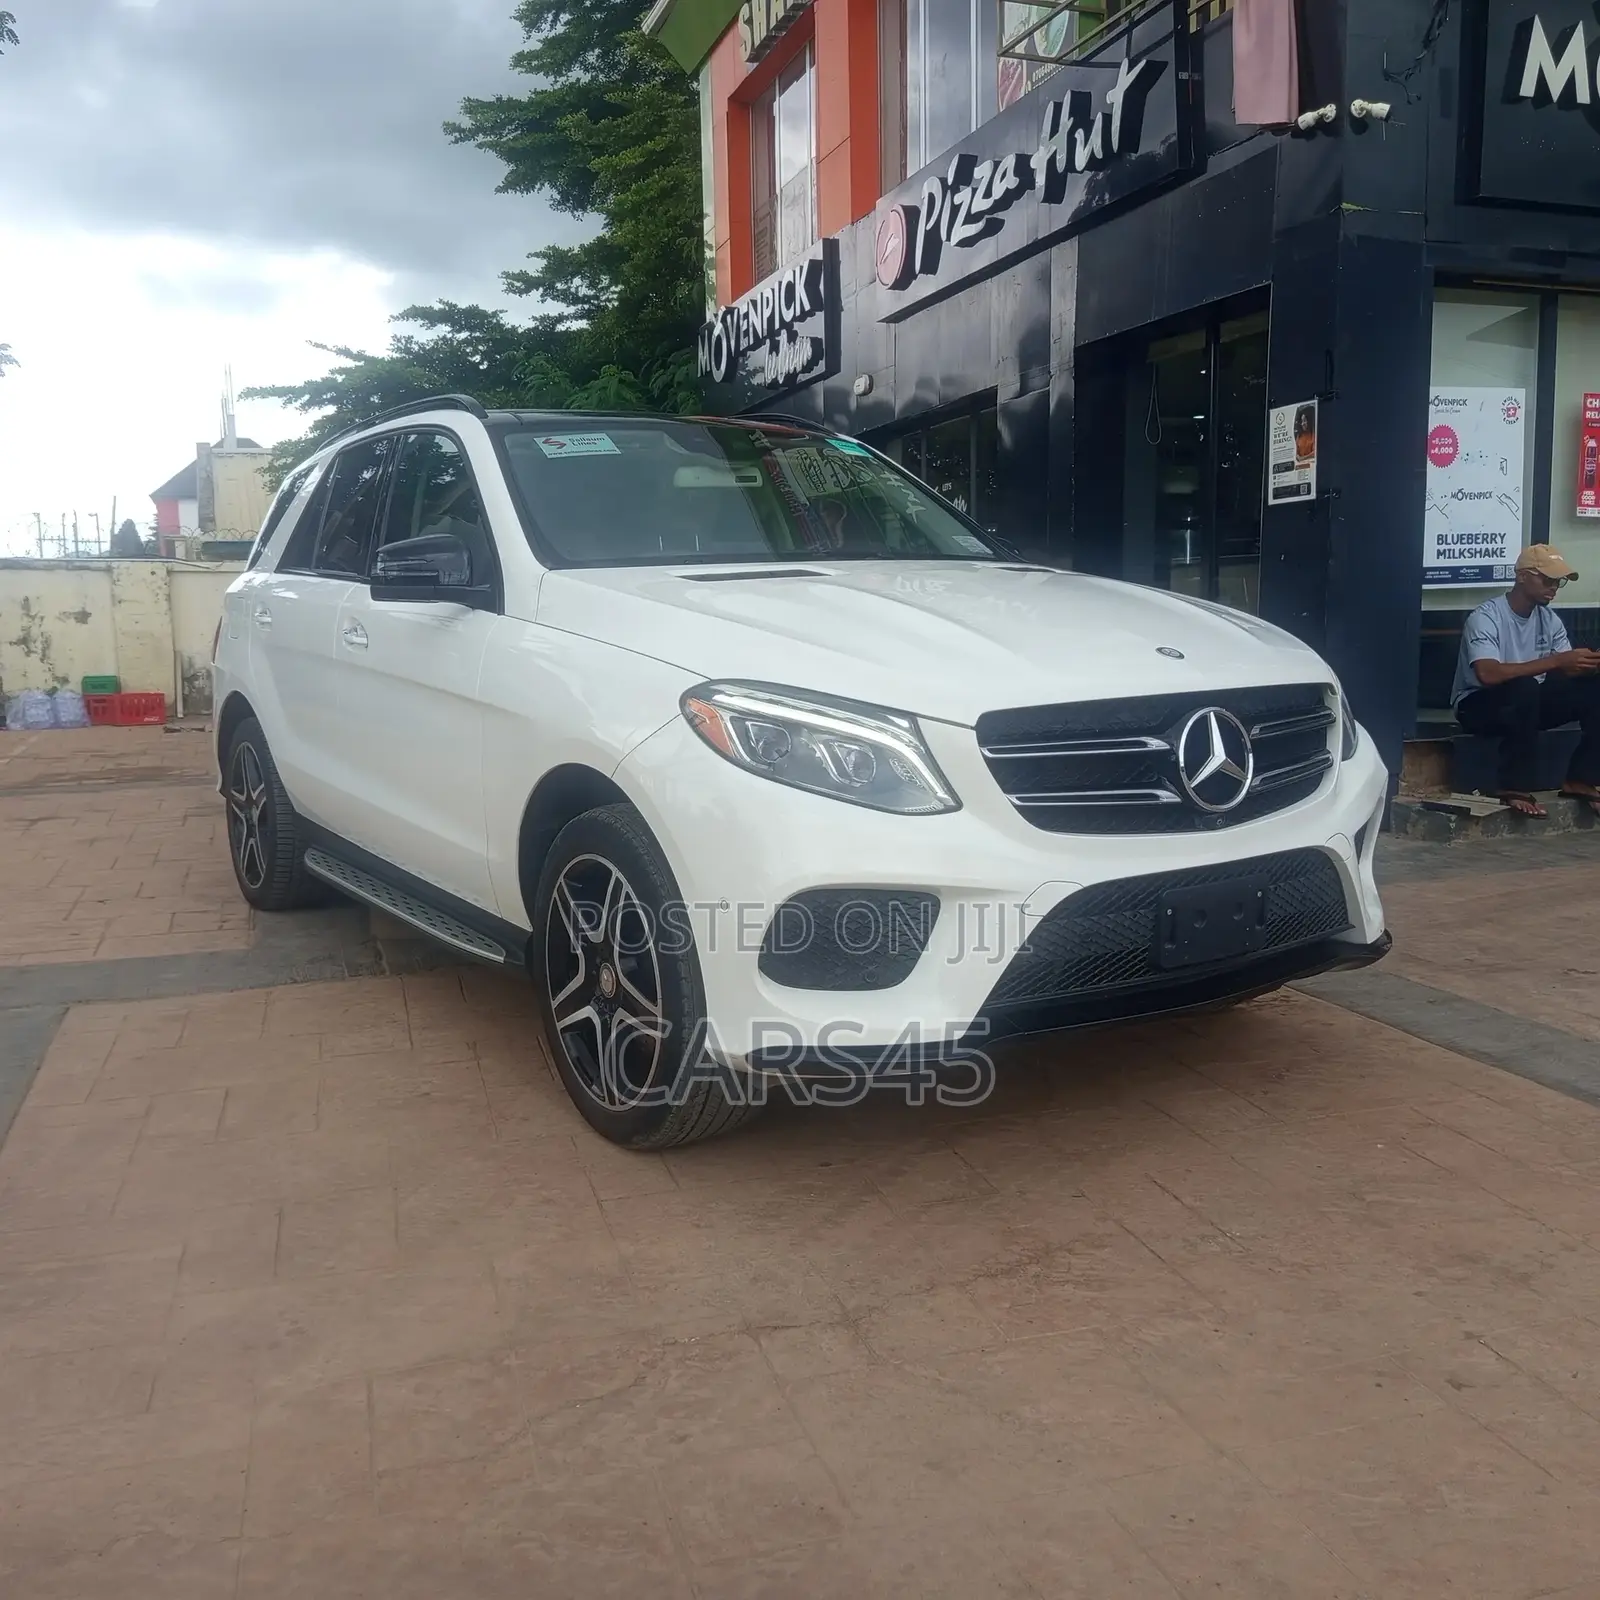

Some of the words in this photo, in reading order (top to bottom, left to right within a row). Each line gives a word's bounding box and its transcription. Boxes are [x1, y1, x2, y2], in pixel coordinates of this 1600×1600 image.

[738, 0, 796, 62] SHA
[1519, 14, 1600, 104] M
[915, 153, 1019, 275] Pizza
[1030, 57, 1146, 186] Hut
[1437, 533, 1506, 546] BLUEBERRY
[1437, 547, 1506, 559] MILKSHAKE
